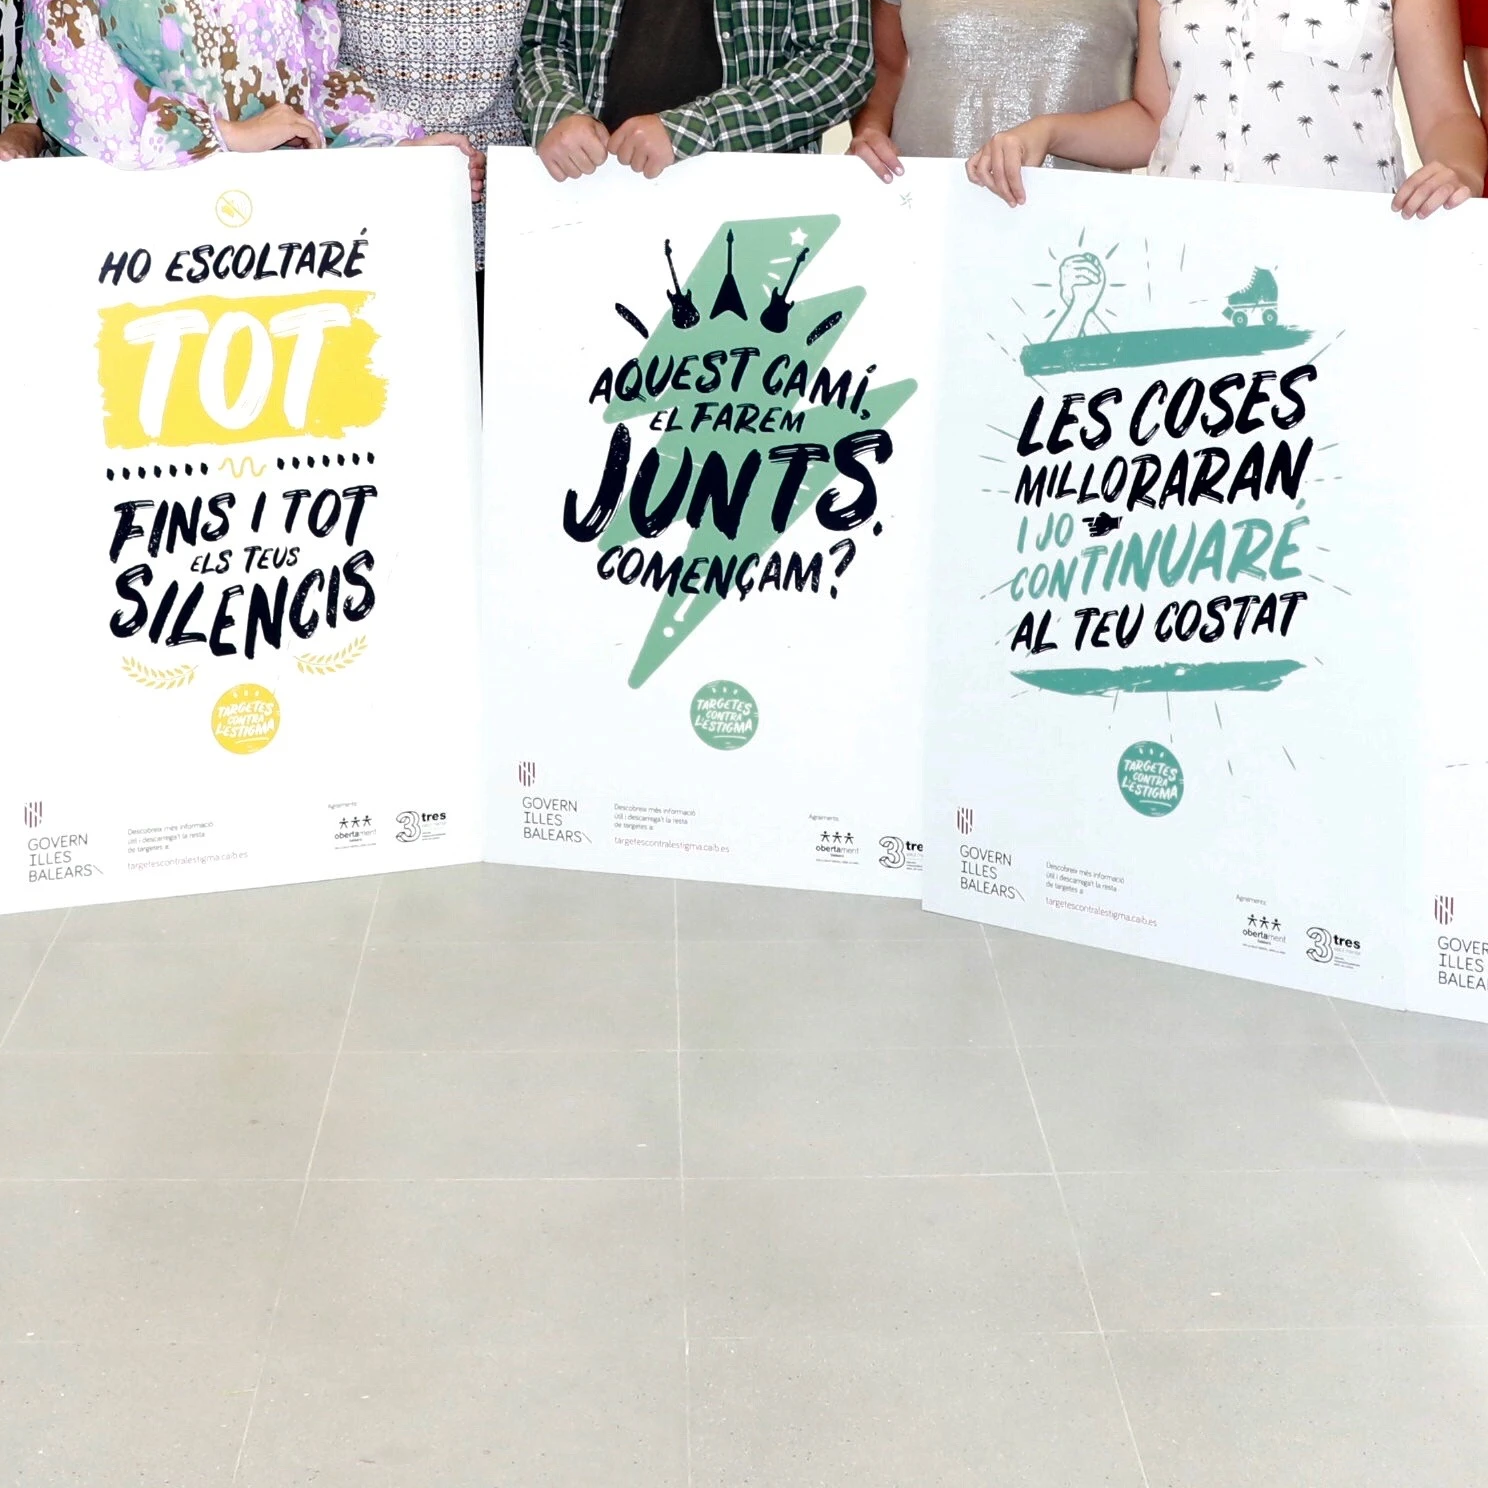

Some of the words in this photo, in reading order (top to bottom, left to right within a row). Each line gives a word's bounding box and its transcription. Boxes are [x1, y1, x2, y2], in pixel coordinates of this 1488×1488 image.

[98, 248, 151, 285] HO
[166, 227, 368, 283] ESCOLTARÉ
[123, 303, 351, 436] TOT
[589, 347, 761, 404] AQUEST
[650, 407, 683, 433] EL
[691, 402, 804, 434] FAREM
[1016, 387, 1122, 456] LES
[1129, 364, 1317, 447] COSES
[563, 422, 893, 543] JUNTS.
[1014, 437, 1313, 512] MILLORARAN
[109, 492, 235, 562] FINS
[251, 491, 266, 532] I
[282, 485, 377, 546] TOT
[1017, 516, 1028, 553] I
[1037, 512, 1074, 551] JO
[190, 552, 230, 574] ELS
[244, 546, 300, 570] TEUS
[1011, 498, 1310, 601] CONTINUARÉ
[597, 538, 857, 602] COMENÇAM?
[109, 549, 375, 659] SILENCIS
[1011, 609, 1057, 654] AL
[1074, 603, 1144, 649] TEU
[1154, 591, 1308, 643] COSTAT
[697, 698, 752, 715] TARGETES
[706, 711, 742, 721] CONTRA
[695, 715, 752, 733] L'ESTIGMA
[1124, 760, 1177, 781] TARGETES
[1133, 772, 1167, 786] CONTRA
[1122, 776, 1177, 800] L'ESTIGMA
[522, 797, 577, 812] GOVERN
[422, 812, 446, 822] tres
[524, 812, 562, 826] ILLES
[28, 833, 88, 851] GOVERN
[906, 841, 923, 851] tre
[30, 851, 71, 866] ILLES
[960, 845, 1012, 866] GOVERN
[961, 861, 997, 879] ILLES
[1334, 934, 1360, 949] tres
[1439, 953, 1484, 972] ILLES
